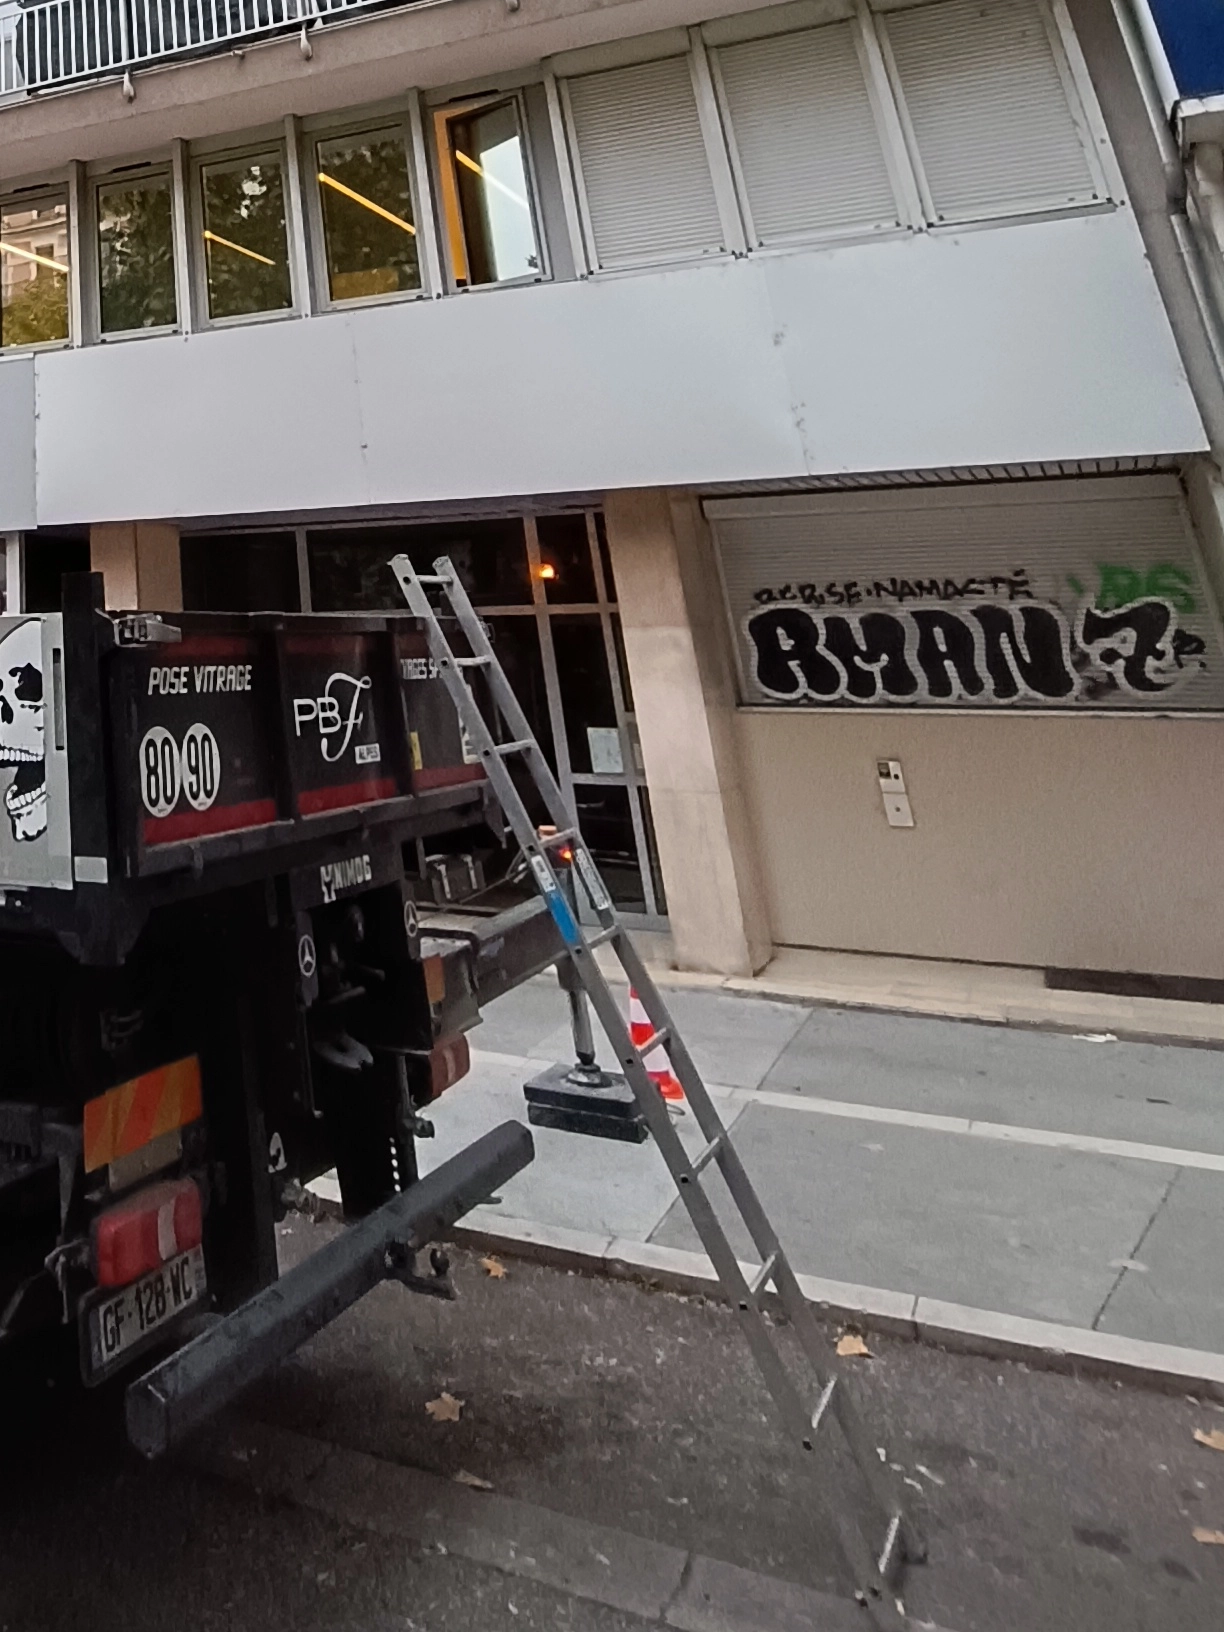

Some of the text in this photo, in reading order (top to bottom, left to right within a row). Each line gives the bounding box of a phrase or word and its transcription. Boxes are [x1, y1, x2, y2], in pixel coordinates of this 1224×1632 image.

[147, 664, 253, 695] POSE VITRAGE
[144, 736, 176, 808] 80
[186, 733, 215, 801] 90
